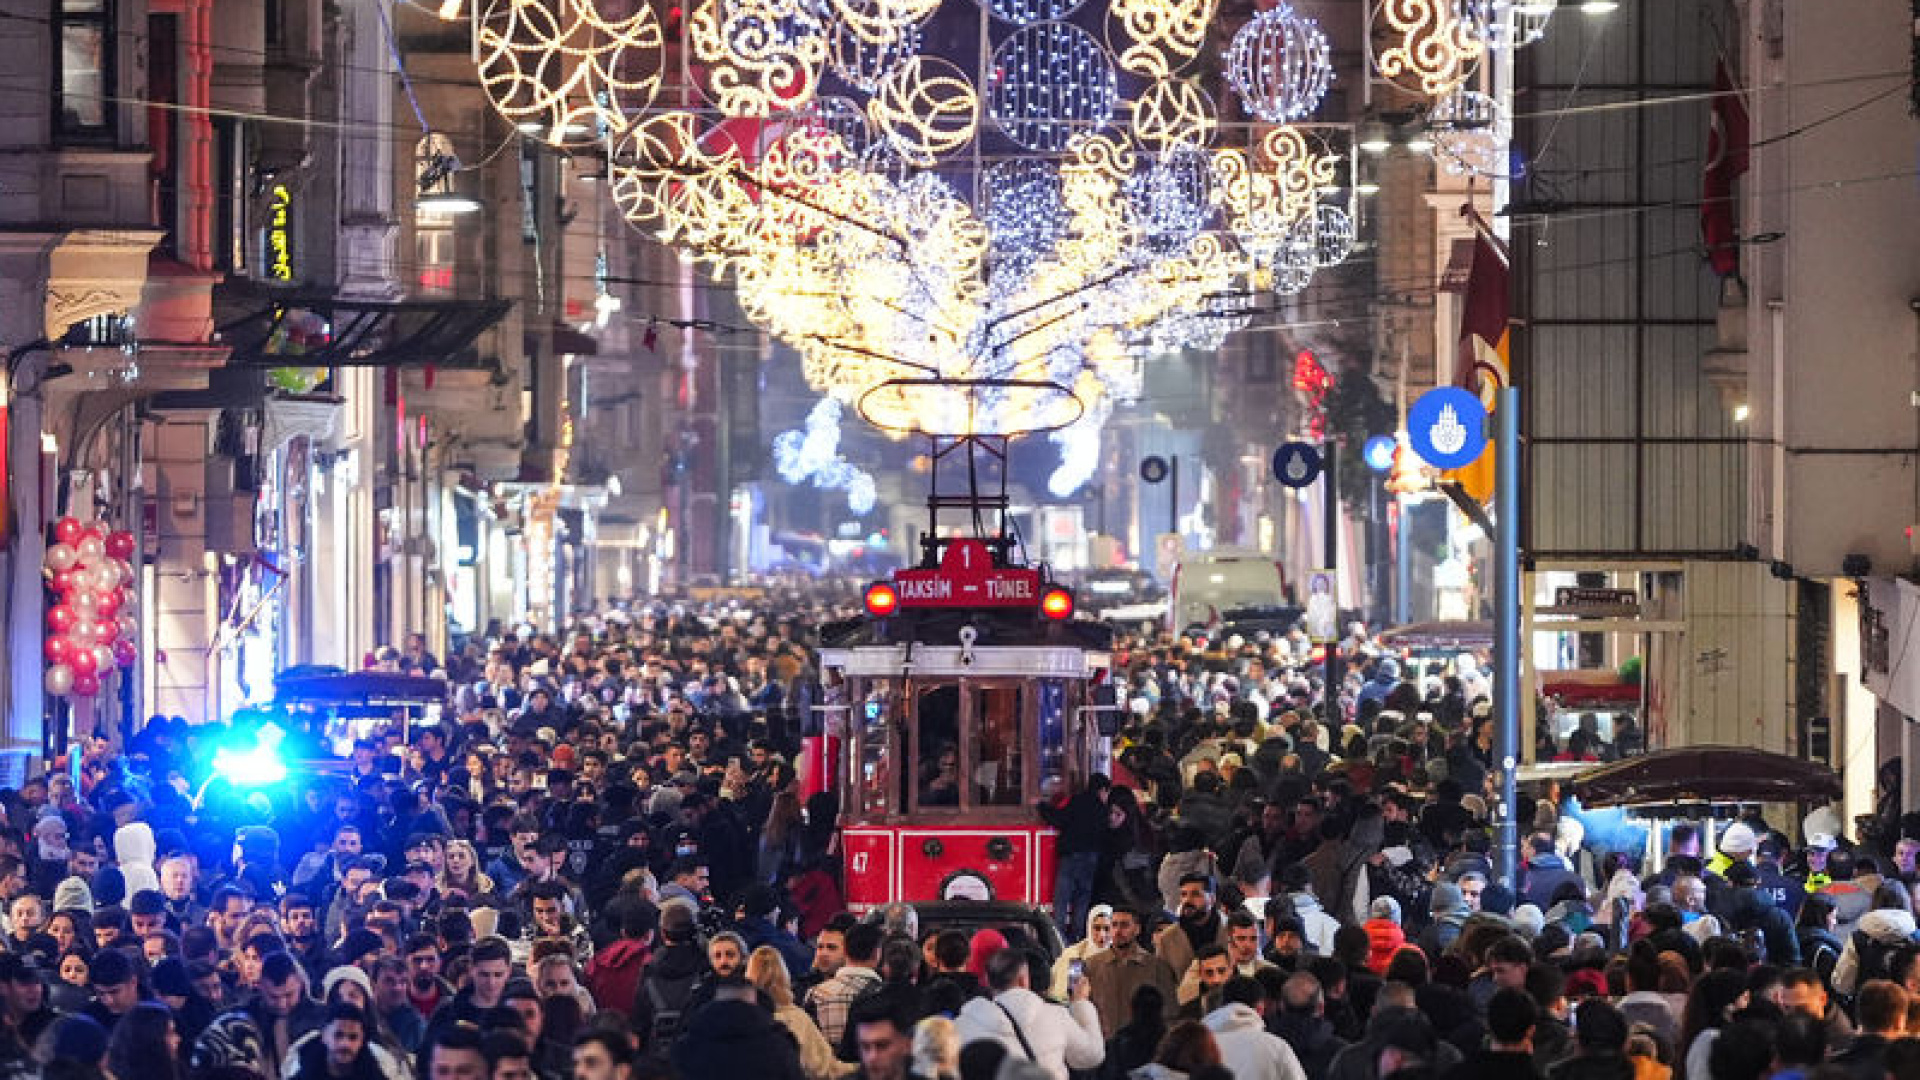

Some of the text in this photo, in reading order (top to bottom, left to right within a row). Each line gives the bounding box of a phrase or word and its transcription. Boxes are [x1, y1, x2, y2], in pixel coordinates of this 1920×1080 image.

[961, 544, 971, 569] 1
[898, 574, 952, 599] TAKSİM
[985, 573, 1033, 599] TÜNEL
[852, 851, 868, 873] 47
